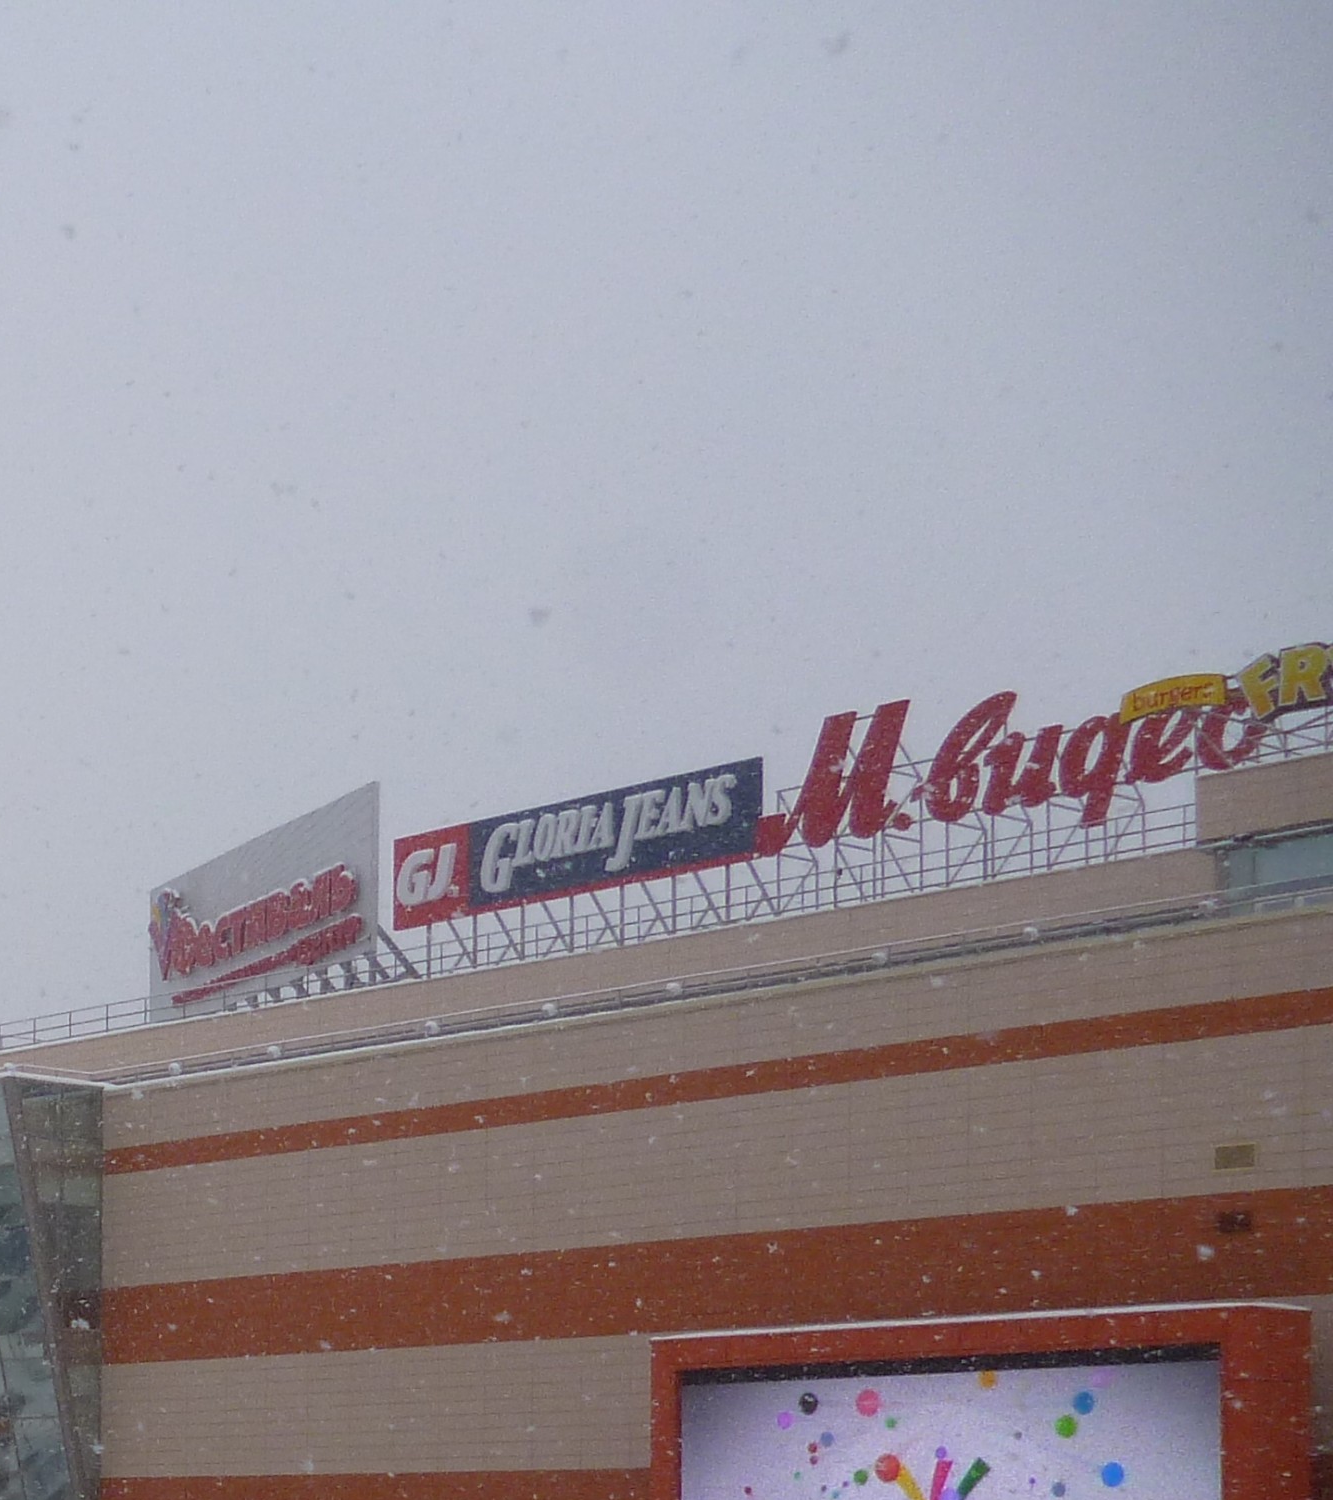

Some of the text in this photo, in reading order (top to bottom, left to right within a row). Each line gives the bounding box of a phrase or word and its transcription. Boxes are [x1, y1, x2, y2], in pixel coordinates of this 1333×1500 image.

[1235, 643, 1333, 720] FR
[480, 774, 737, 894] GLORIA JEANS
